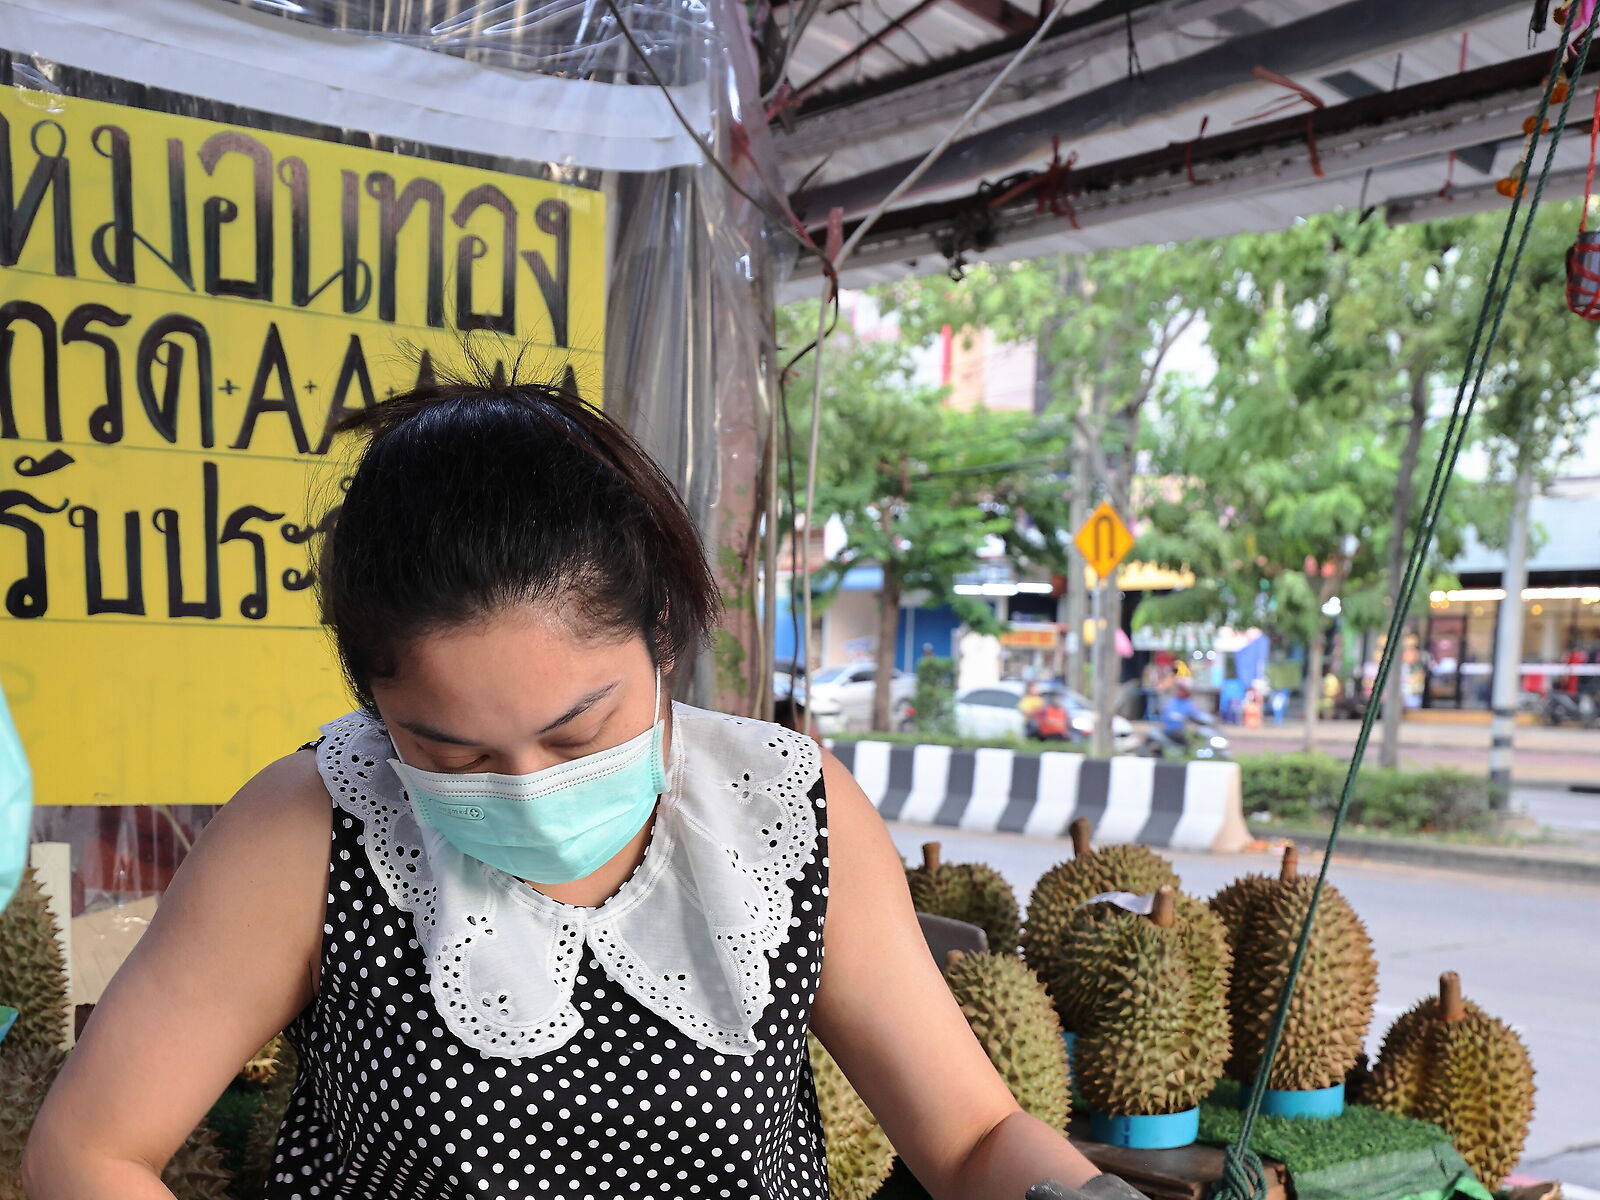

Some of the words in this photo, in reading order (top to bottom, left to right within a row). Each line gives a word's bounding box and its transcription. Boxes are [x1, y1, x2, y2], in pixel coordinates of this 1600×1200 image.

[0, 112, 570, 347] หมอนทอง
[0, 450, 351, 625] รับประ
